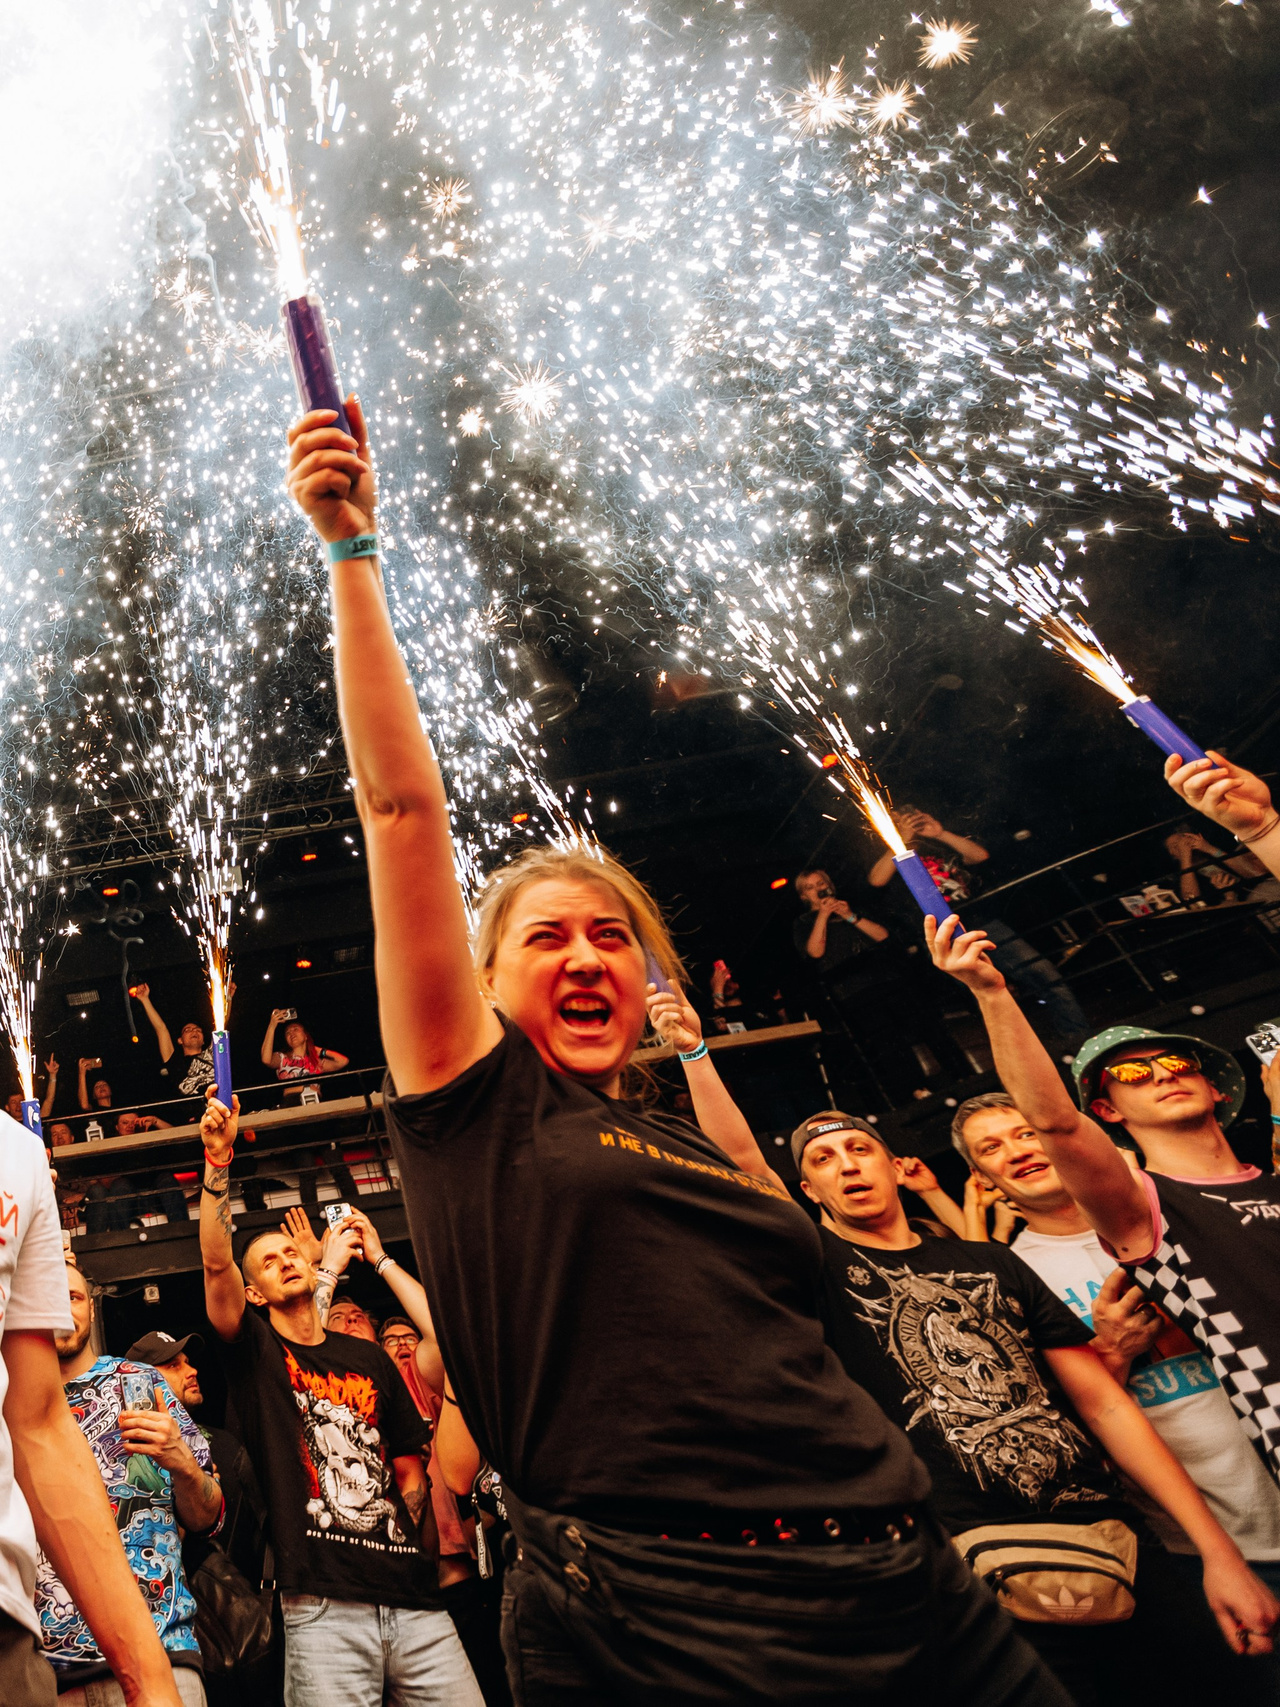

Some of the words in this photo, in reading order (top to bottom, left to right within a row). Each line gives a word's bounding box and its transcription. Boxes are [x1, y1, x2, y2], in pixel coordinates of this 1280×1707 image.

[817, 1121, 844, 1133] ZENIT
[599, 1132, 616, 1147] И
[618, 1135, 645, 1154] НЕ
[646, 1144, 661, 1159] В
[906, 1350, 938, 1386] MORS
